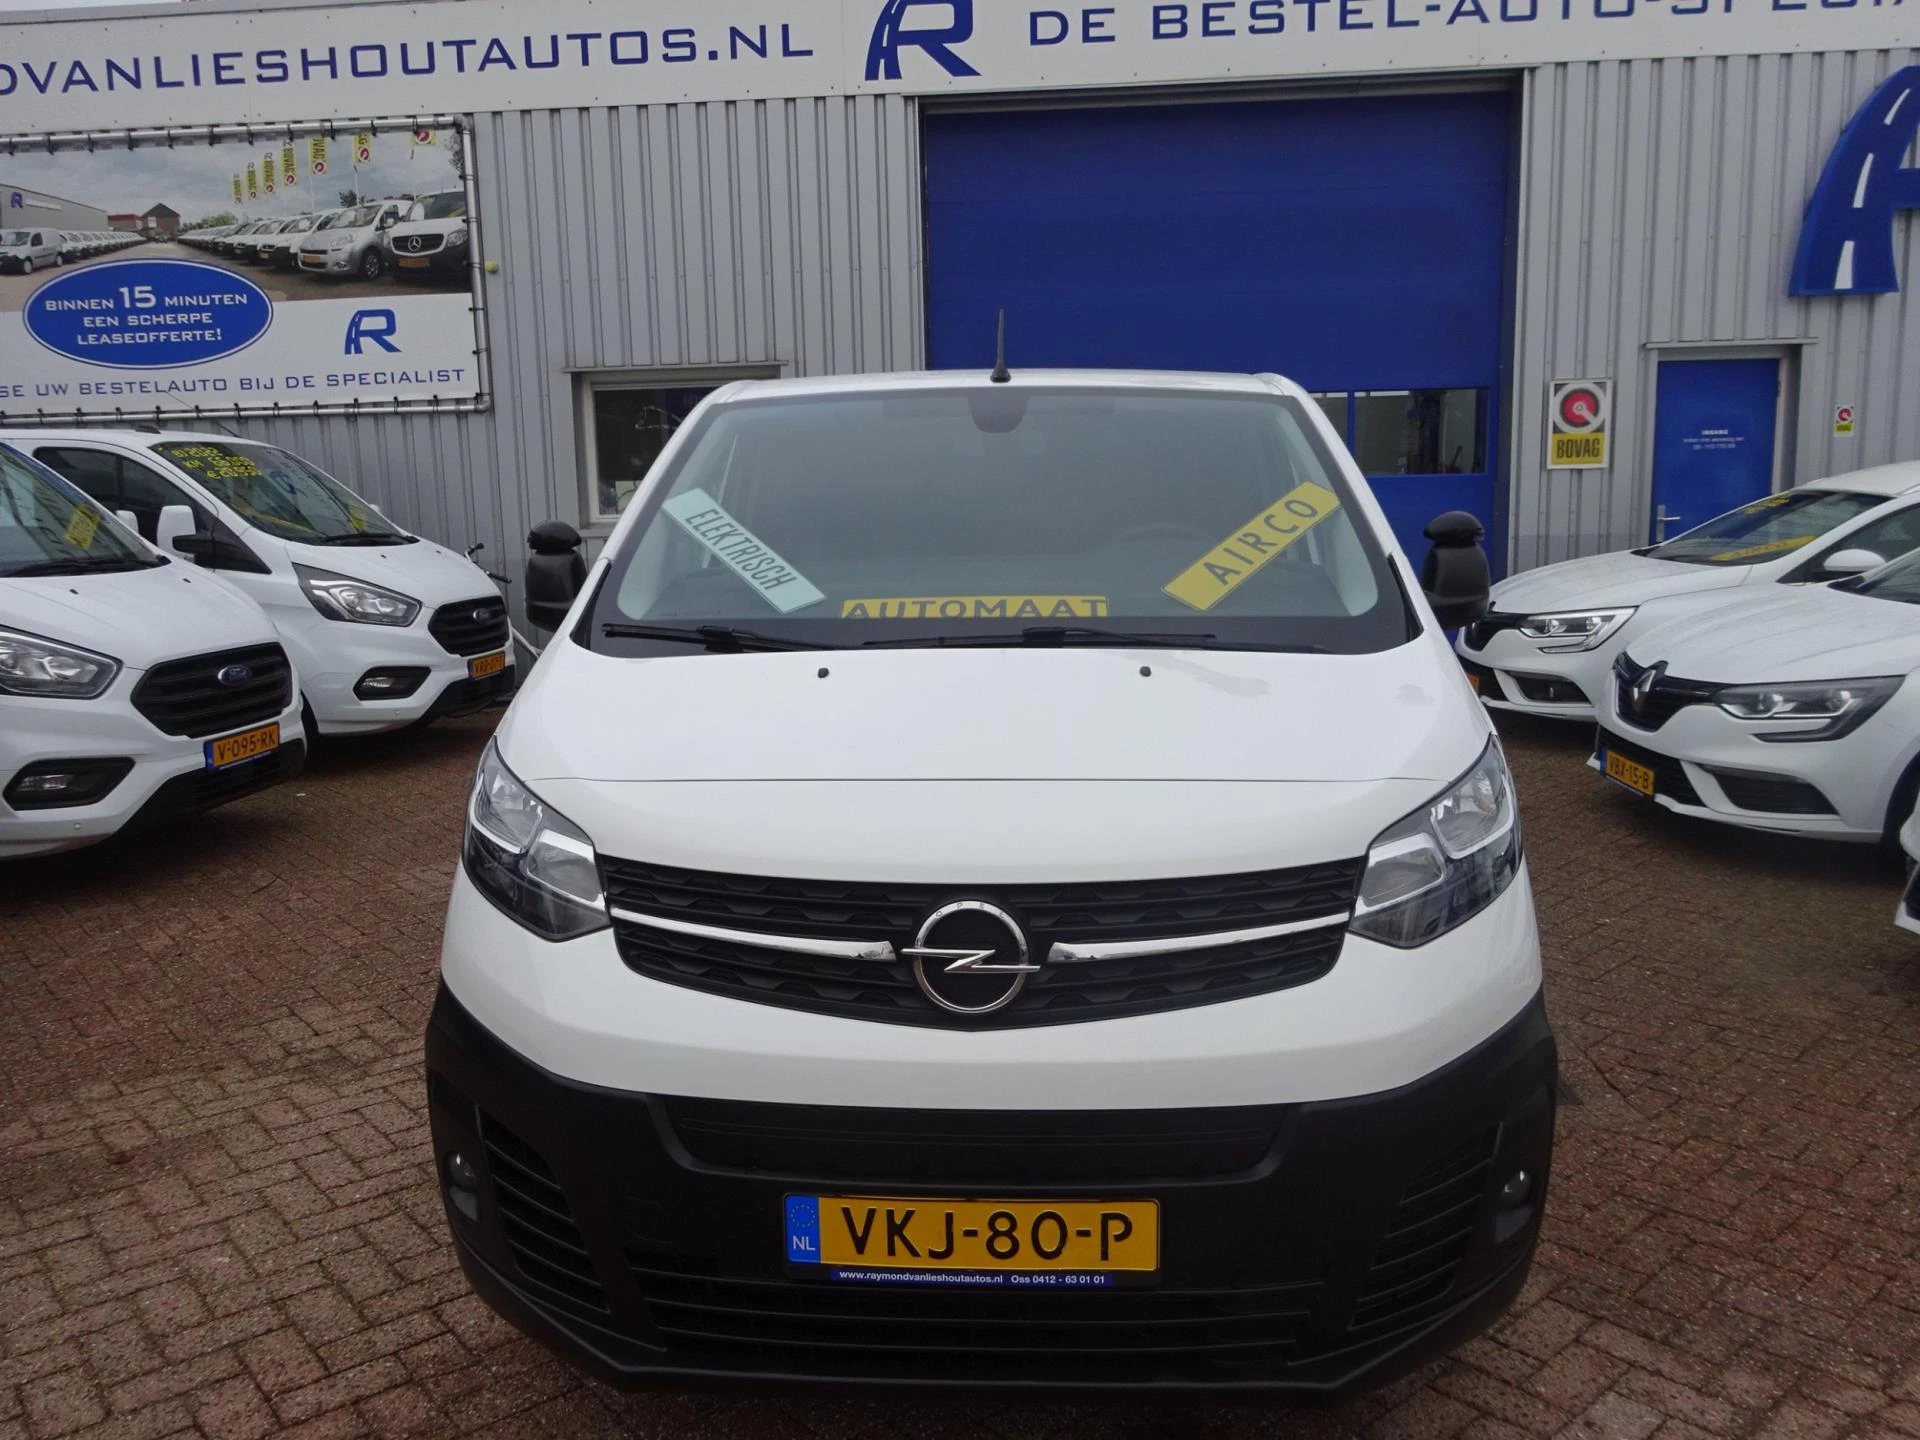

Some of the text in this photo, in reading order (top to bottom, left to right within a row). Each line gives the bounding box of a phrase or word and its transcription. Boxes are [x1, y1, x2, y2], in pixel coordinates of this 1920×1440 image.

[1029, 8, 1116, 46] DE
[45, 285, 248, 312] BINNEN 15 MINUTEN
[83, 312, 213, 327] EEN SCHERPE
[77, 327, 222, 346] LEASEOFFERTE!
[36, 382, 70, 397] UW
[79, 377, 227, 396] BESTELAUTO
[240, 373, 275, 391] BIJ
[285, 374, 316, 389] DE
[326, 368, 466, 388] SPECIALIST
[1556, 438, 1601, 459] BOVAG
[685, 508, 798, 591] ELEKTRISCH
[1203, 498, 1318, 586] AIRCO
[848, 600, 1105, 618] AUTOMAAT
[792, 1205, 1134, 1262] NL VKJ-80-P
[839, 1270, 1003, 1284] www.raymondvanlieshoutautos.nl
[1010, 1274, 1031, 1284] Oss
[1032, 1274, 1057, 1284] 0412
[1064, 1274, 1078, 1284] 63
[1079, 1274, 1091, 1284] 01
[1093, 1274, 1105, 1284] 01
